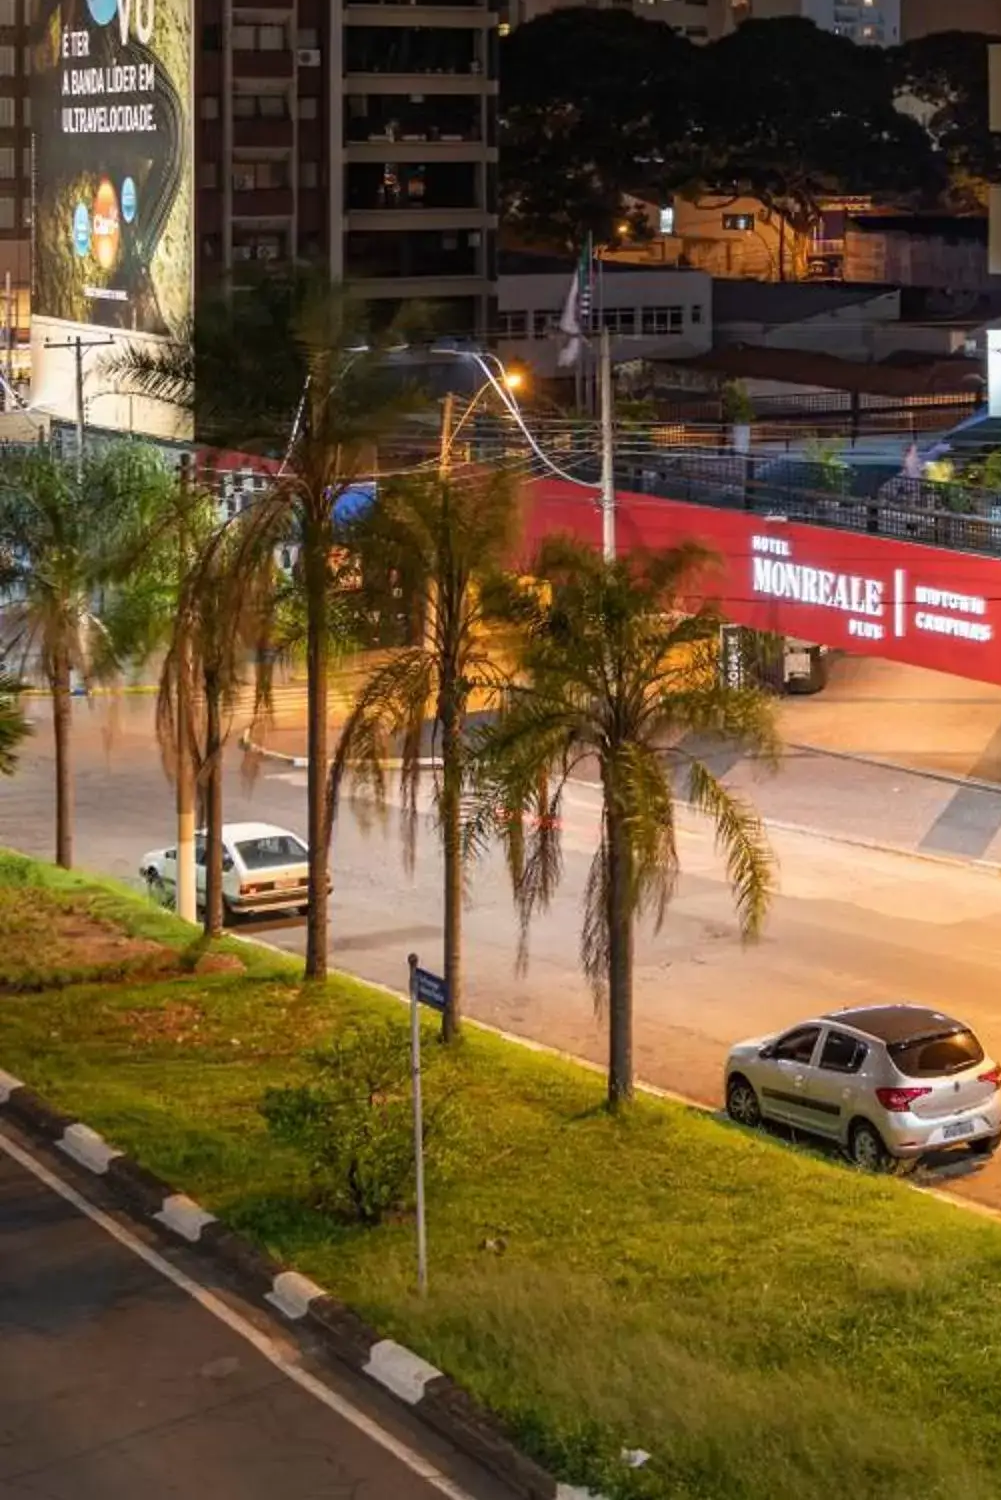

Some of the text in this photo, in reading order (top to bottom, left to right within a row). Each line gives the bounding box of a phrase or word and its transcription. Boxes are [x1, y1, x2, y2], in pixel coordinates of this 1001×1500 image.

[71, 31, 90, 57] TER
[62, 58, 155, 96] A BANDA LÍDER EM
[752, 535, 791, 556] HOTEL
[753, 556, 884, 617] MONREALE
[915, 611, 993, 642] CAMPINAS
